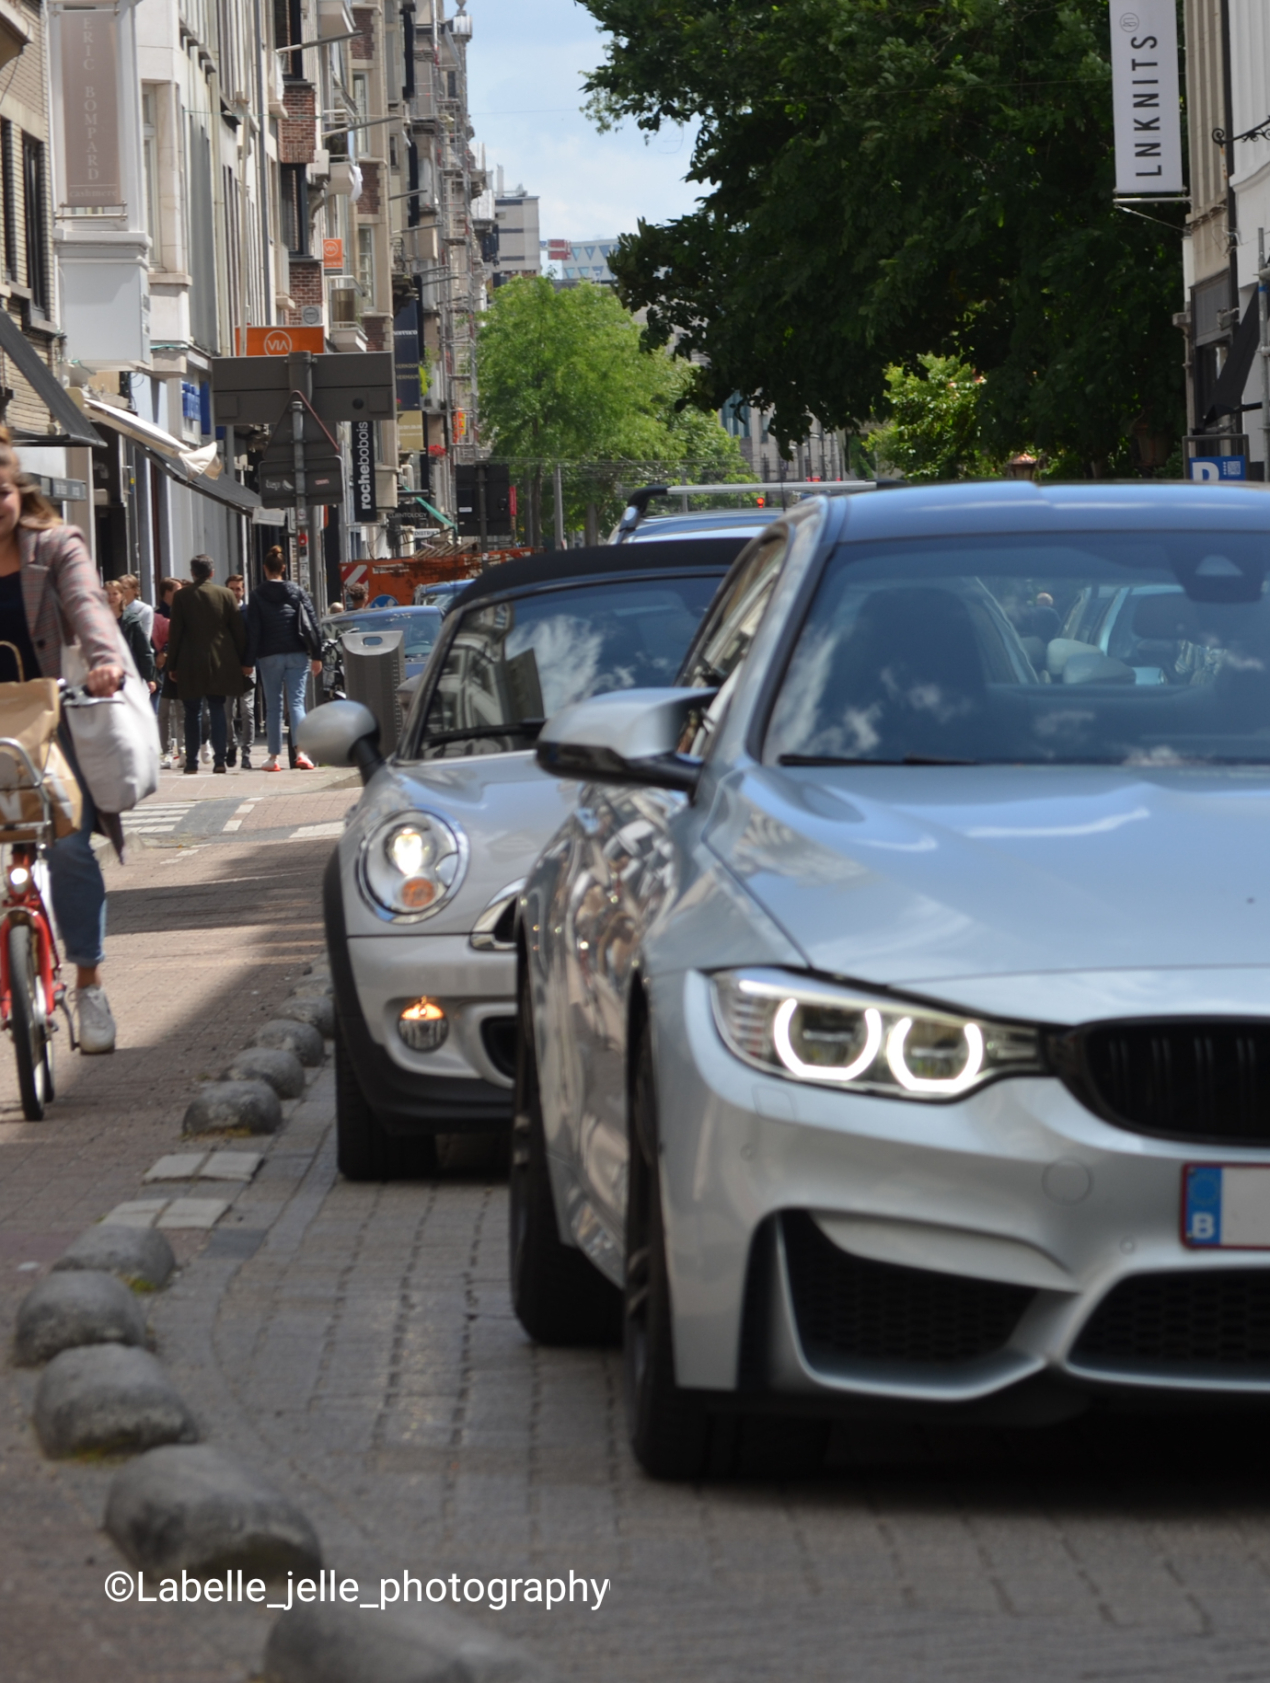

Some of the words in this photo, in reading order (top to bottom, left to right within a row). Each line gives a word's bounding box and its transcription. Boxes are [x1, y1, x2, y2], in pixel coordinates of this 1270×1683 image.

[83, 17, 95, 71] ERIC
[84, 86, 99, 180] BOMPARD
[267, 340, 289, 351] VIA
[356, 421, 371, 509] rochebobois
[1193, 1212, 1215, 1239] B
